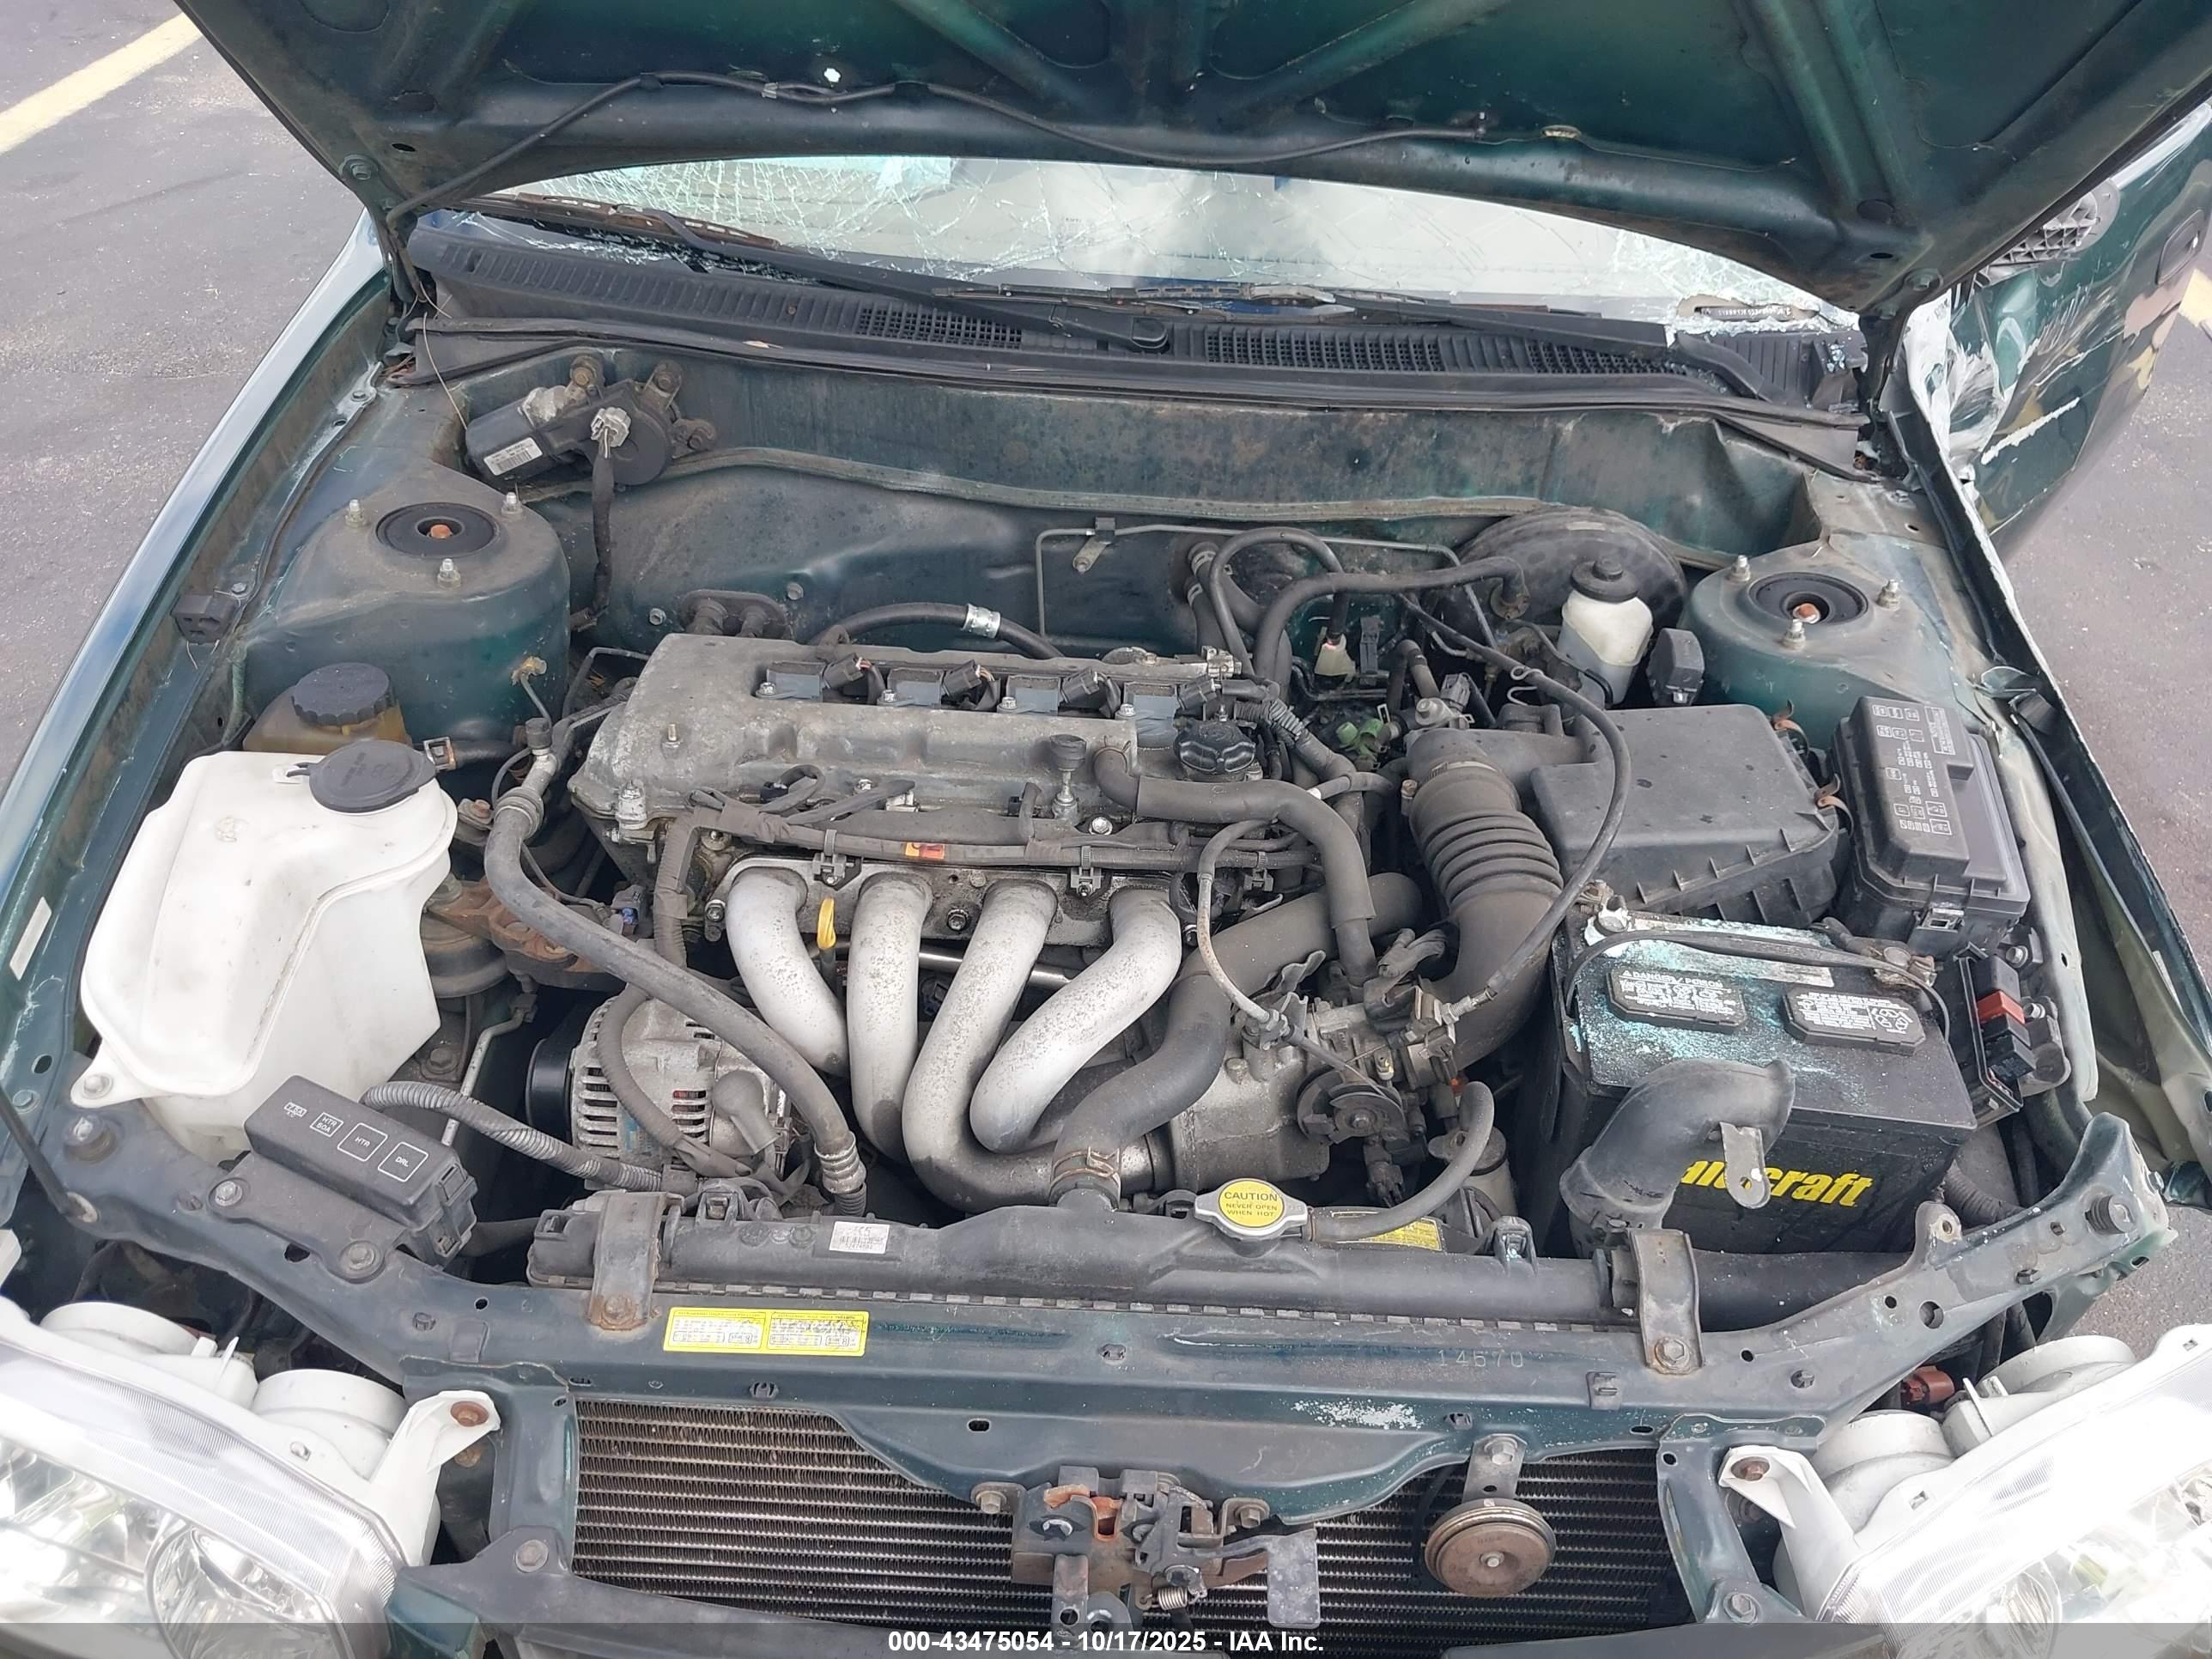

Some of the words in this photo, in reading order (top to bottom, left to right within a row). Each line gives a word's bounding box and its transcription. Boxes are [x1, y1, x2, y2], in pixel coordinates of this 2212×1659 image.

[321, 1116, 337, 1127] HTR
[354, 1136, 371, 1147] HTR
[395, 1156, 409, 1167] DRL
[1224, 1192, 1278, 1202] CAUTION
